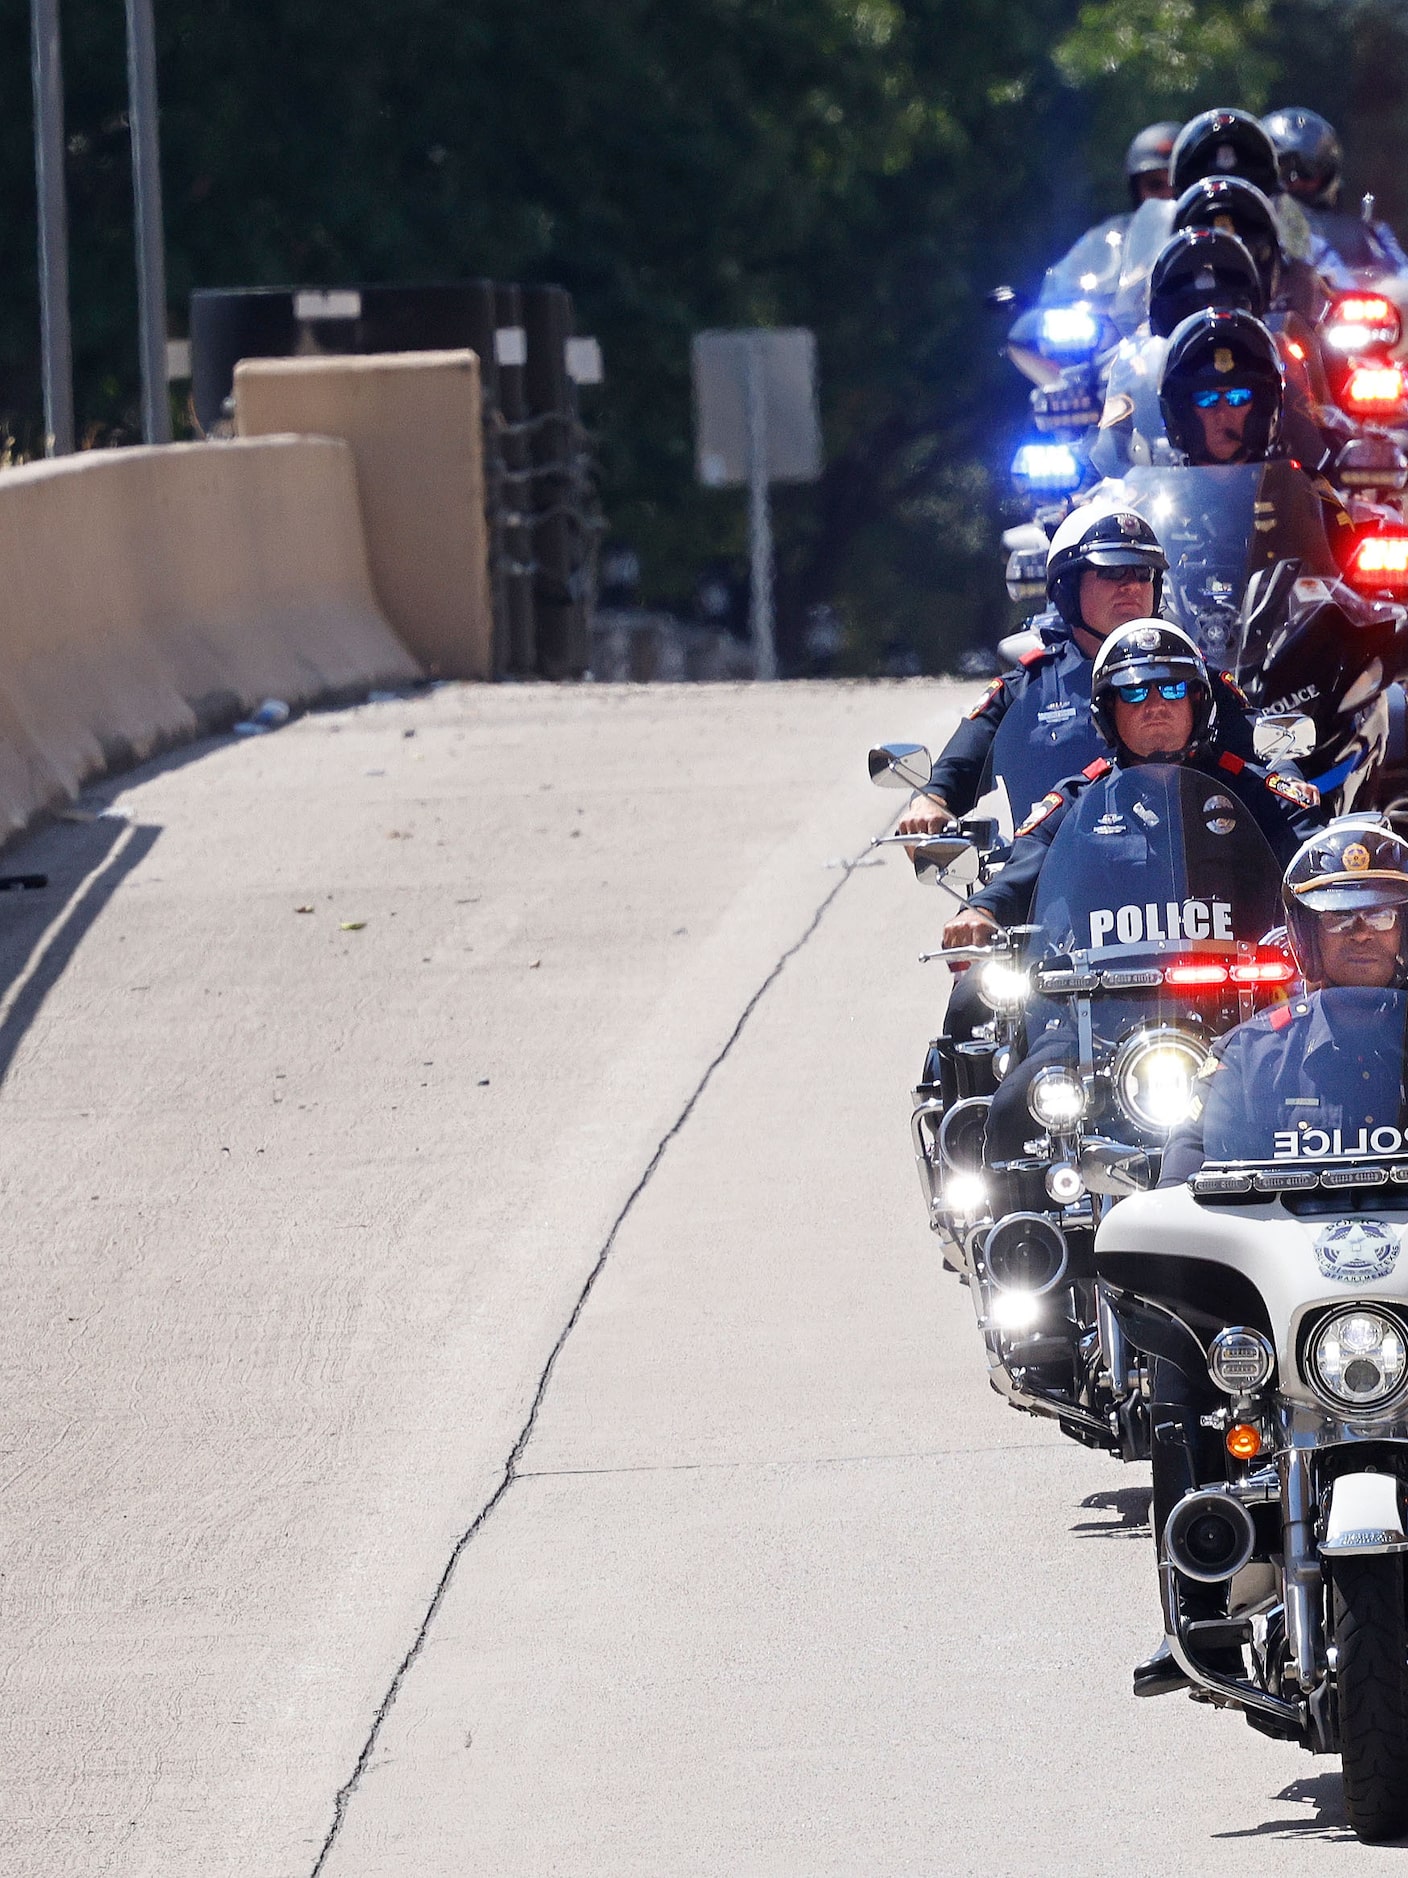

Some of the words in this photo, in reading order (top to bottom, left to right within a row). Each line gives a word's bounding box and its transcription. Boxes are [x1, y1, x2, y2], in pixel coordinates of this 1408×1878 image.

[1262, 683, 1320, 717] POLICE
[1089, 901, 1234, 949] POLICE
[1324, 1267, 1392, 1283] DEPARTMENT
